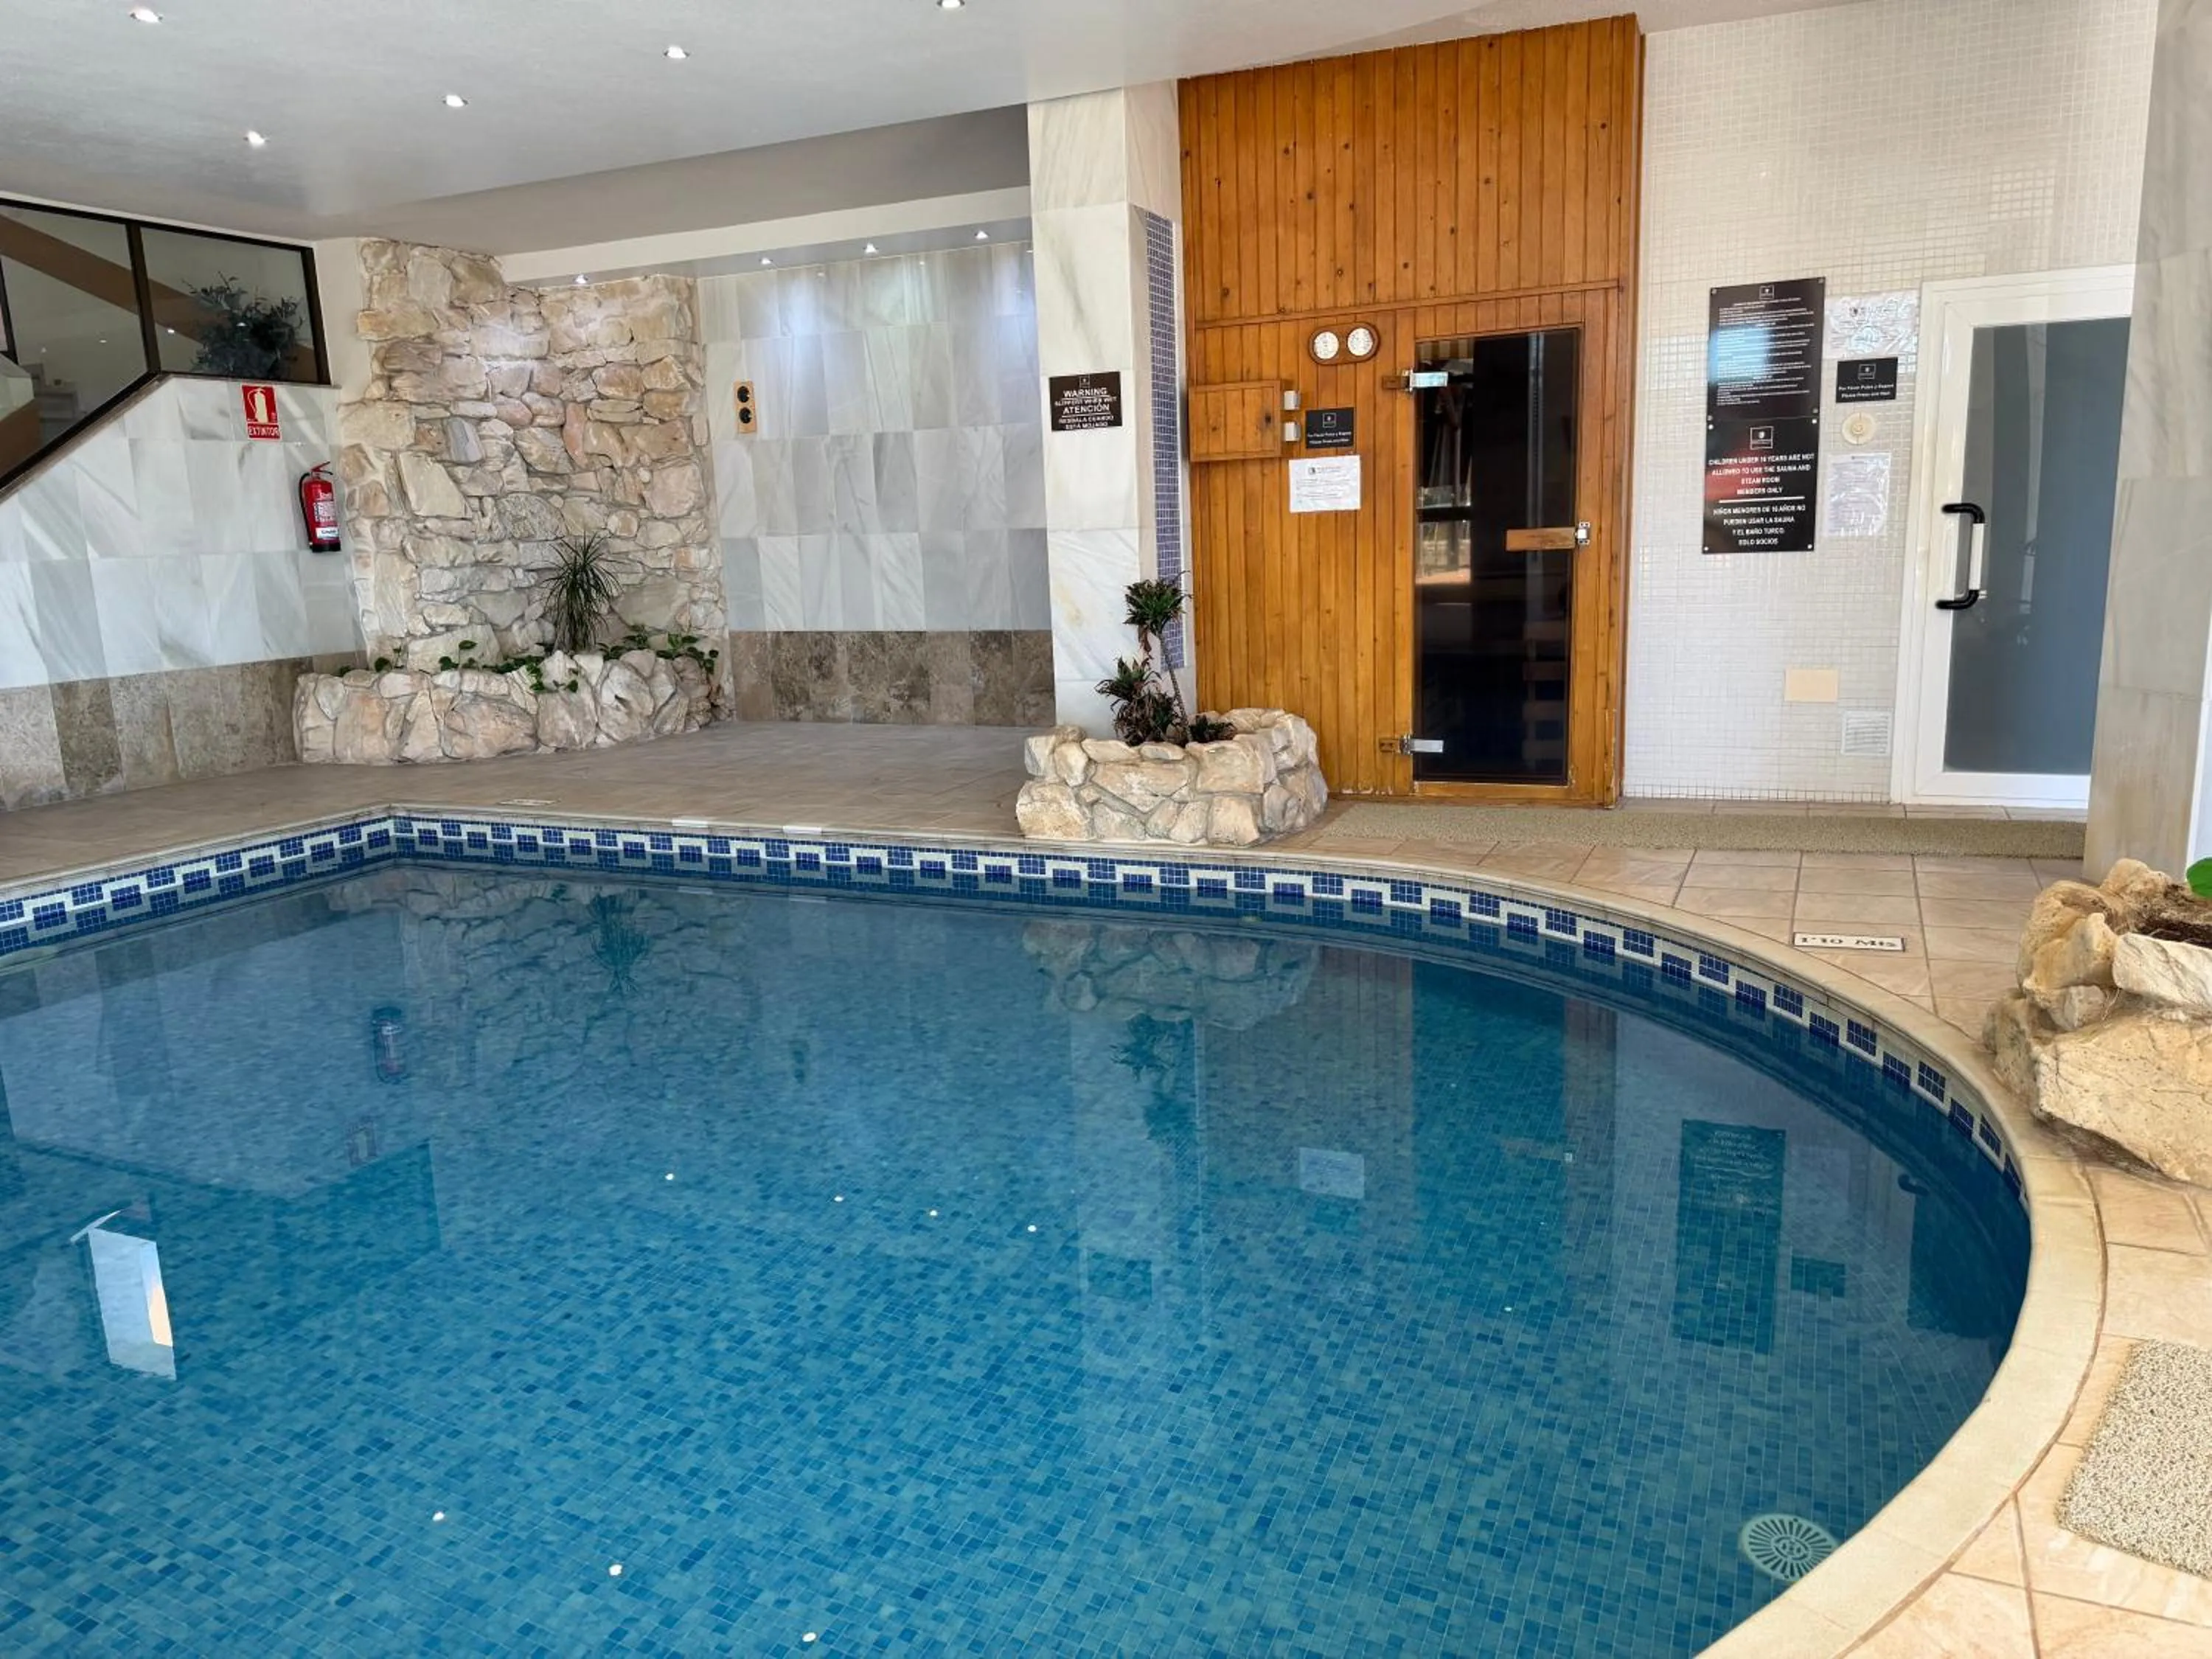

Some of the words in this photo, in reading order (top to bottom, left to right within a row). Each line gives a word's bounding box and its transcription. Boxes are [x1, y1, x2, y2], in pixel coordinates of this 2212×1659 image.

[1062, 387, 1107, 397] WARNING
[1062, 403, 1110, 414] ATENCIÓN
[1708, 458, 1738, 466] CHILDREN
[1756, 538, 1778, 546] SOCIOS
